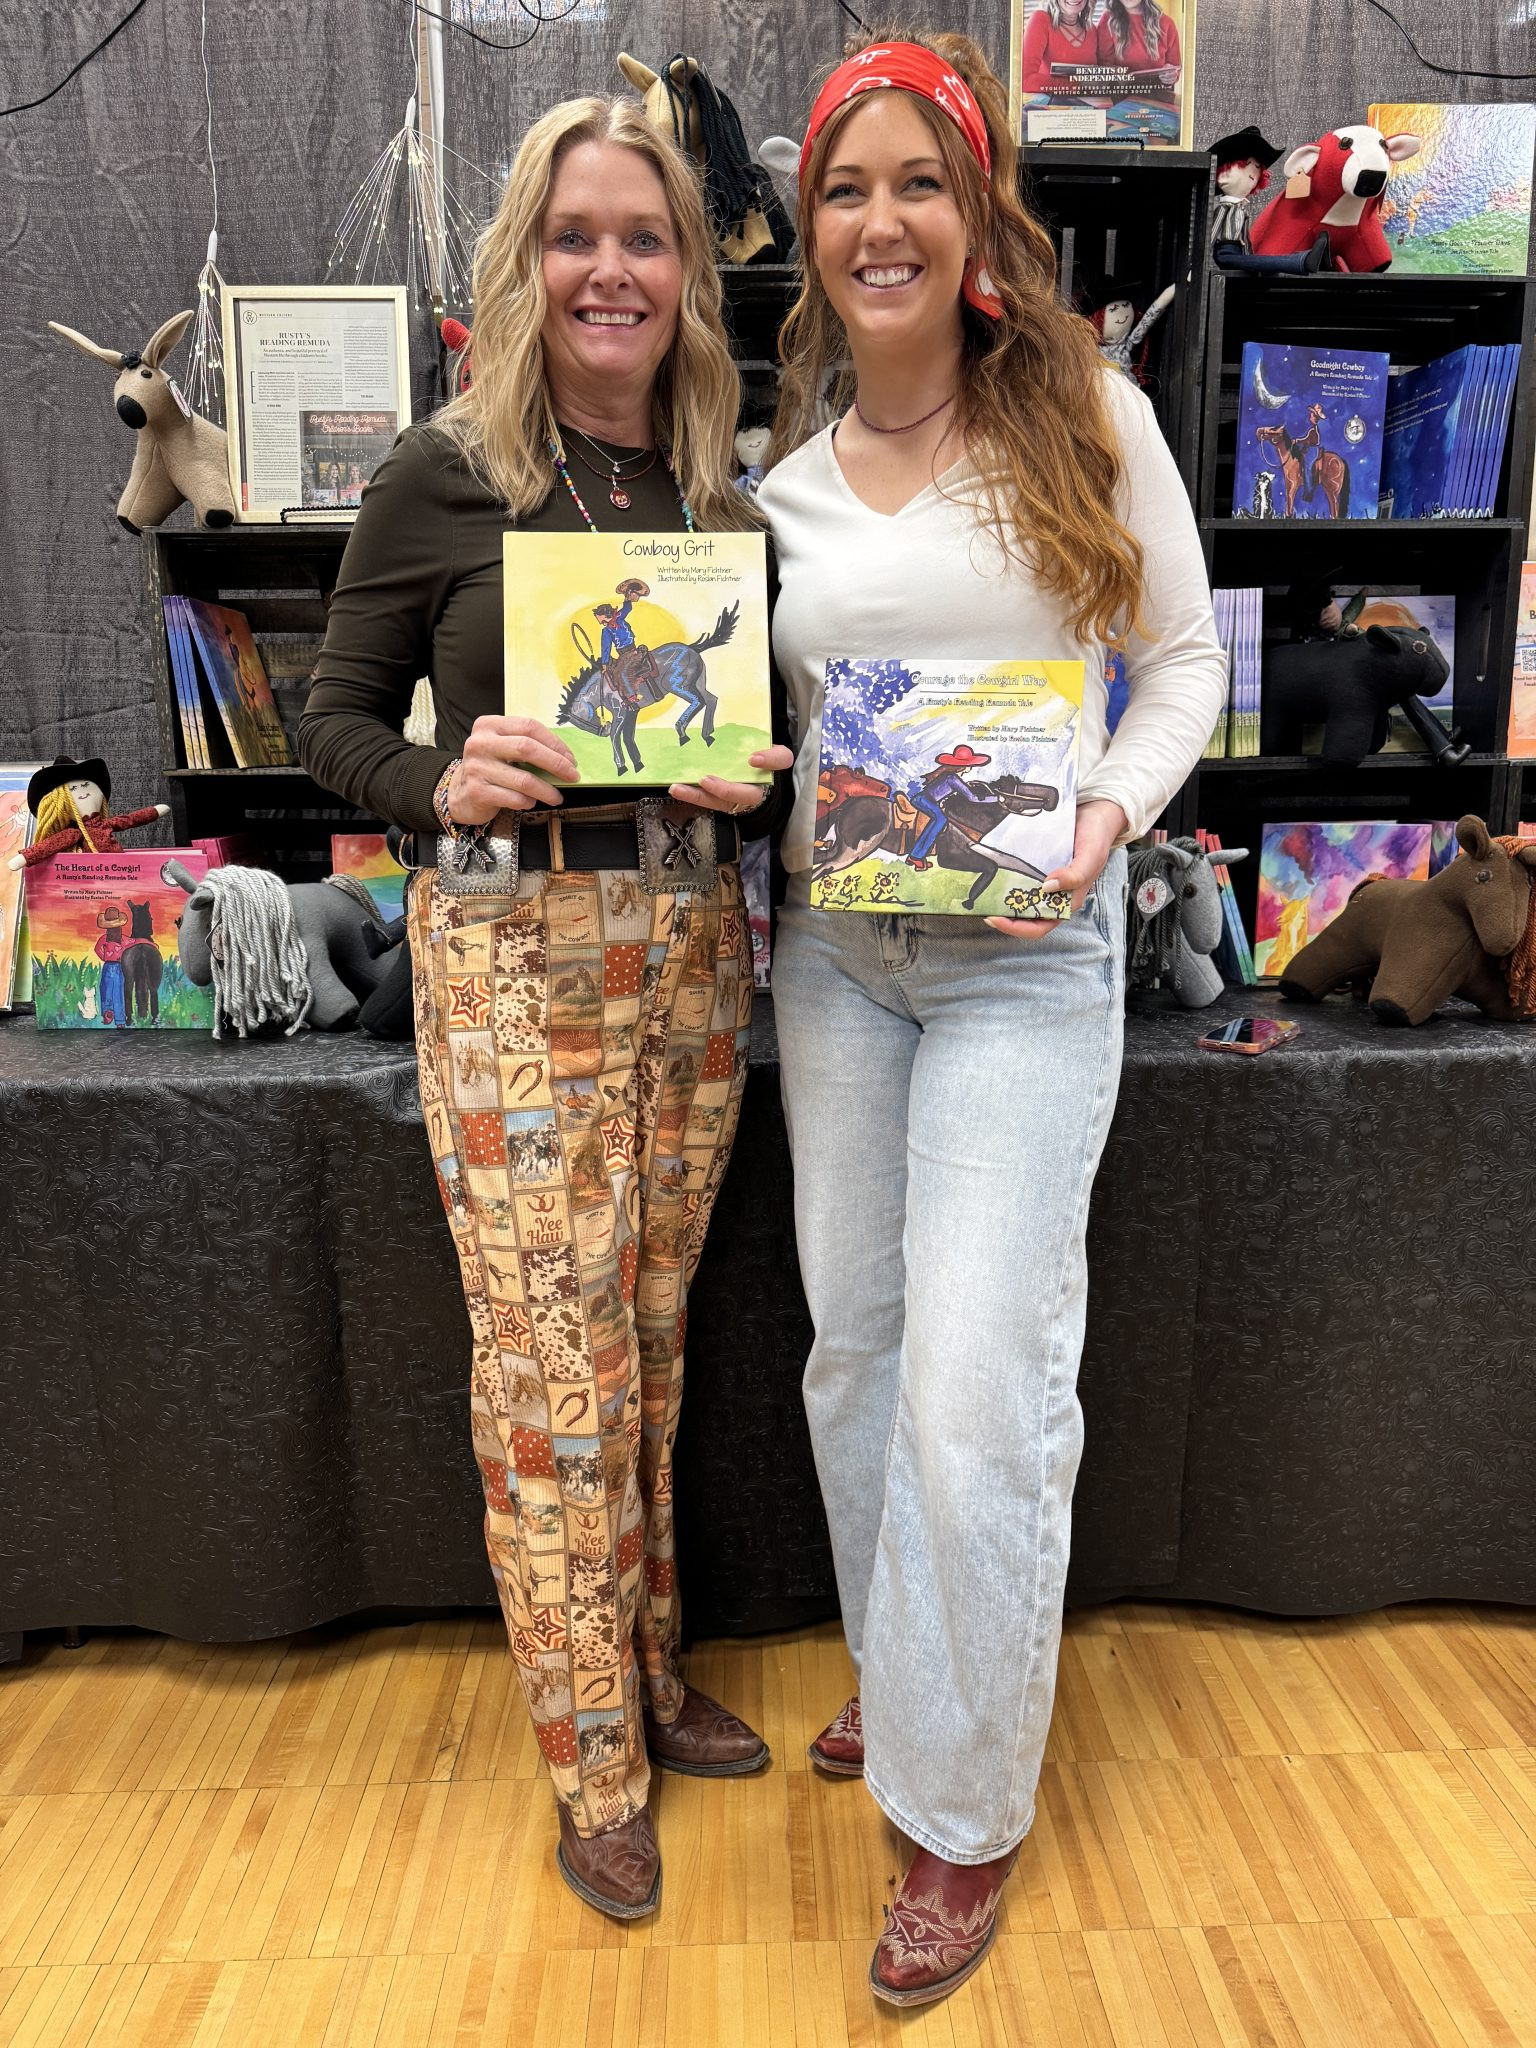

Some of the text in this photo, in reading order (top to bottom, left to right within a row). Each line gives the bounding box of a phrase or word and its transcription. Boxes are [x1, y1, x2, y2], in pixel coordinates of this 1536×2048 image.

[1069, 74, 1135, 82] INDEPENDENCE:
[1310, 359, 1365, 372] Goodnight Cowboy
[309, 414, 332, 423] Rusty's
[334, 415, 359, 424] Reading
[321, 425, 374, 434] Children's Books
[623, 539, 715, 563] Cowboy Grit
[657, 566, 733, 576] Written by Mary Fichtner
[657, 574, 688, 582] Illustrated
[688, 575, 697, 584] by
[911, 673, 1048, 688] Courage the Cowgirl Way
[917, 698, 1034, 708] A Rusty's Reading Remuda Tale
[968, 724, 991, 732] Written
[992, 725, 1000, 734] by
[1001, 725, 1018, 734] Mary
[1000, 735, 1008, 744] by
[71, 864, 94, 872] Heart
[111, 864, 141, 873] Cowgirl
[1141, 879, 1159, 889] MADE
[1138, 900, 1164, 912] WYOMING
[558, 931, 591, 942] THE COWBOY
[534, 1217, 563, 1232] Yee
[527, 1230, 563, 1246] Haw
[464, 1261, 482, 1274] Ye
[651, 1305, 672, 1314] COWBOY
[580, 1531, 605, 1546] Yee
[575, 1537, 606, 1556] Haw
[598, 1785, 618, 1804] Yee
[597, 1795, 622, 1820] Haw
